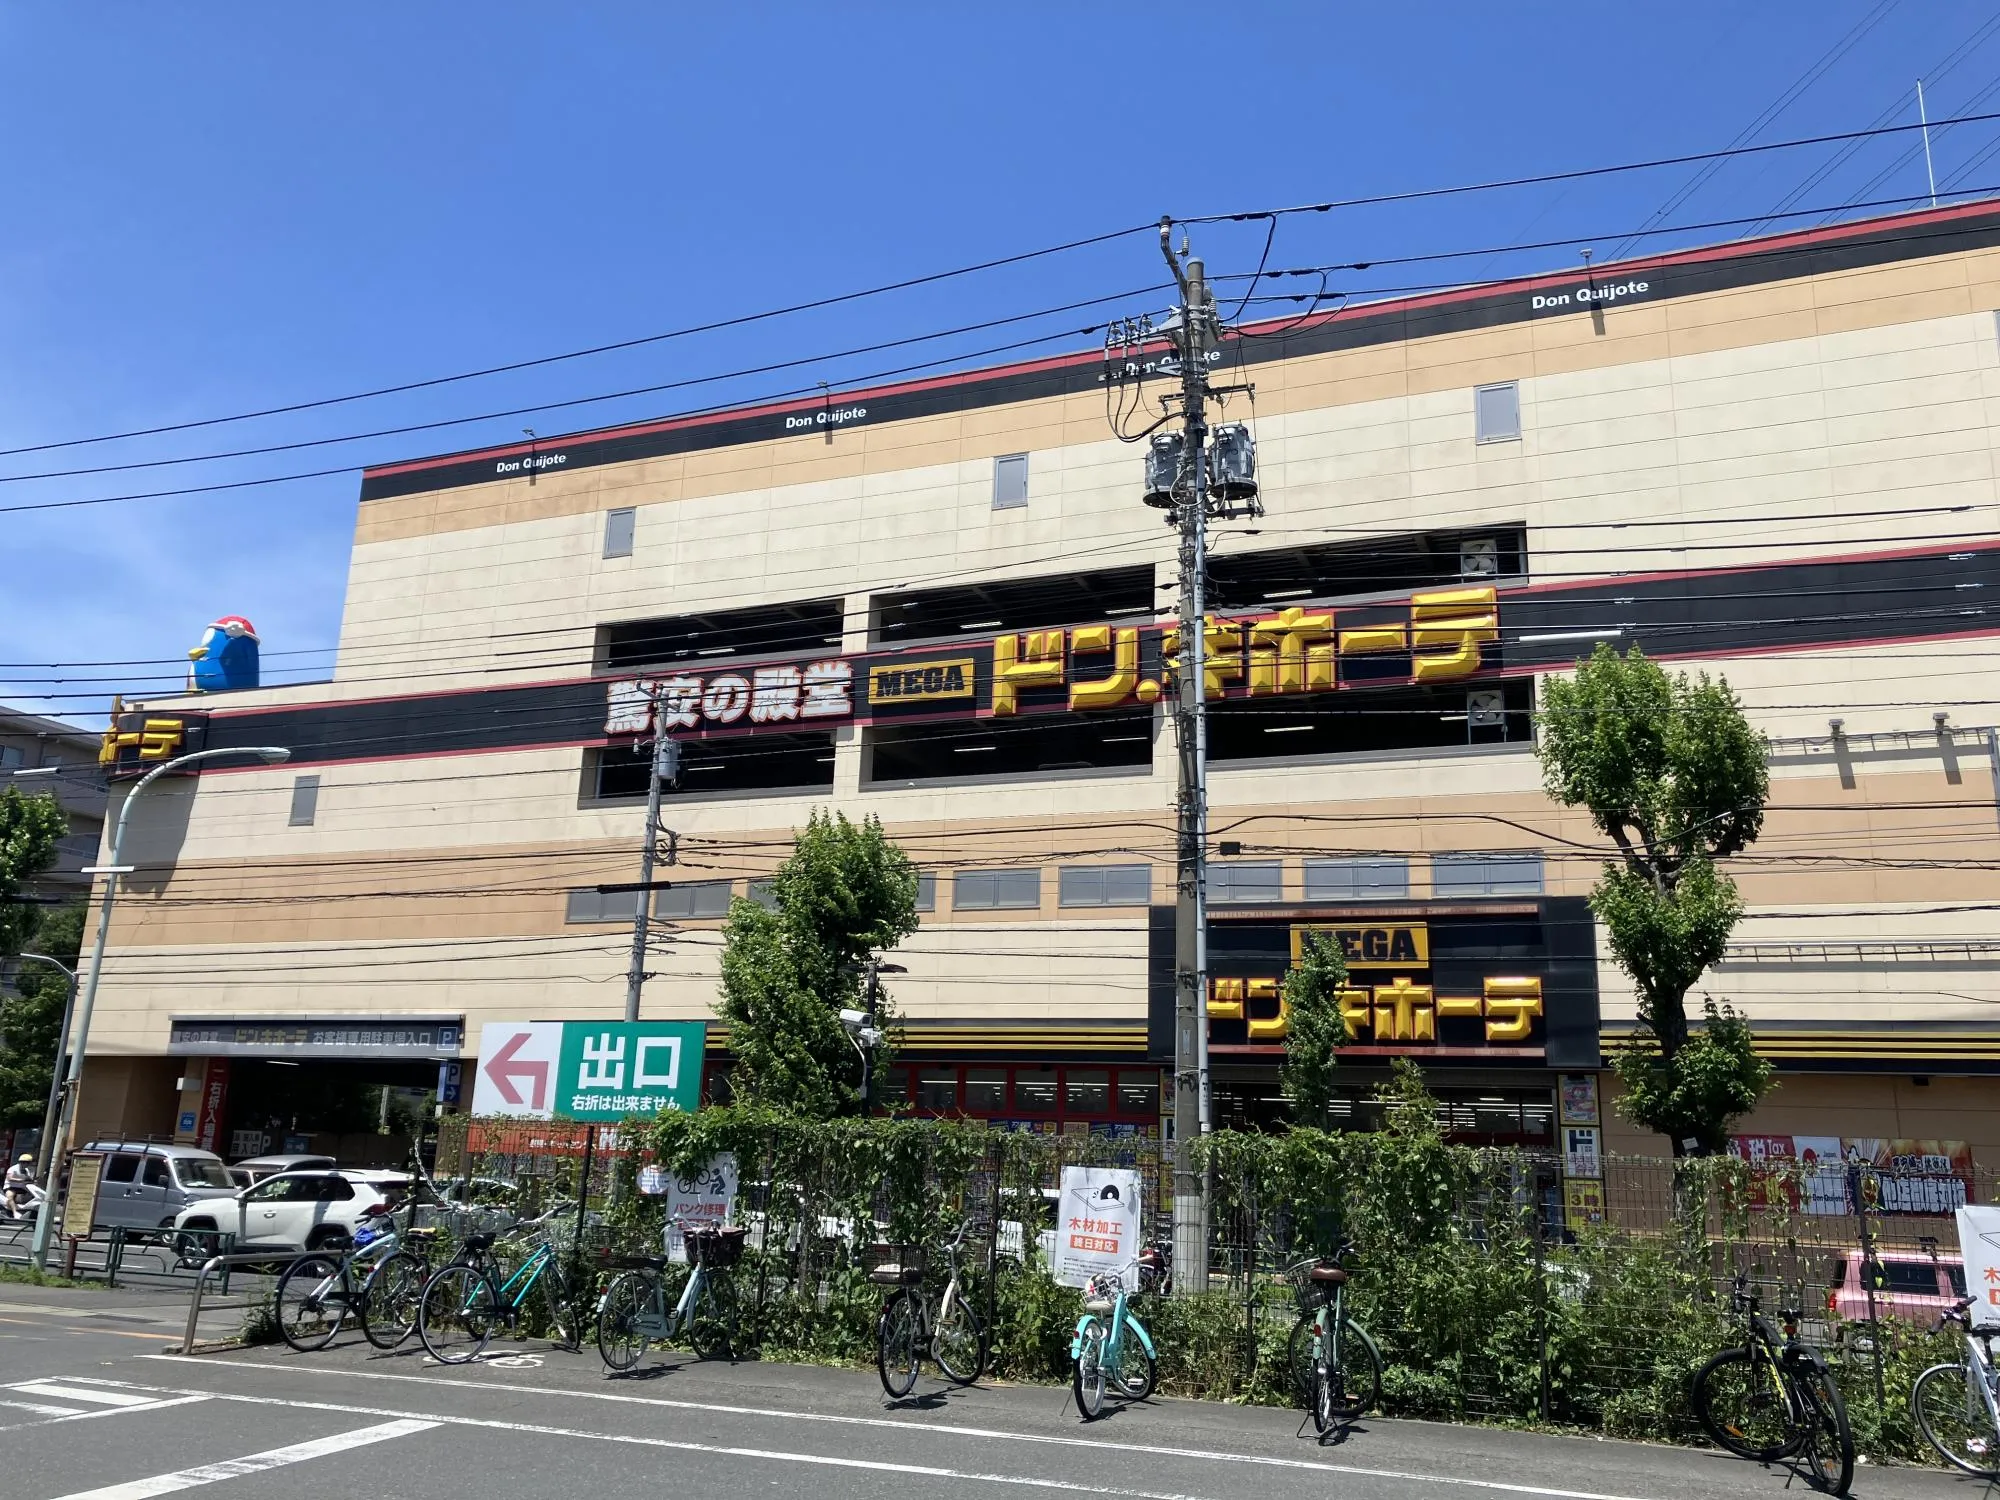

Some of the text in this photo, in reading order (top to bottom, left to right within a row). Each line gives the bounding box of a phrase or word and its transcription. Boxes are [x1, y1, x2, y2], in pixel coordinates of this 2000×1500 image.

[1532, 281, 1649, 309] Don Quijote
[786, 407, 867, 429] Don Quijote
[496, 454, 566, 473] Don Quijote
[876, 665, 965, 698] MEGA
[312, 1031, 432, 1046] お客様専用駐車場入口
[441, 1031, 453, 1046] P
[577, 1033, 682, 1089] 出口
[571, 1094, 681, 1111] 右折は出来ません
[1766, 1139, 1786, 1155] Tax
[1068, 1217, 1123, 1236] 木材加工
[1073, 1236, 1115, 1252] 終日対応
